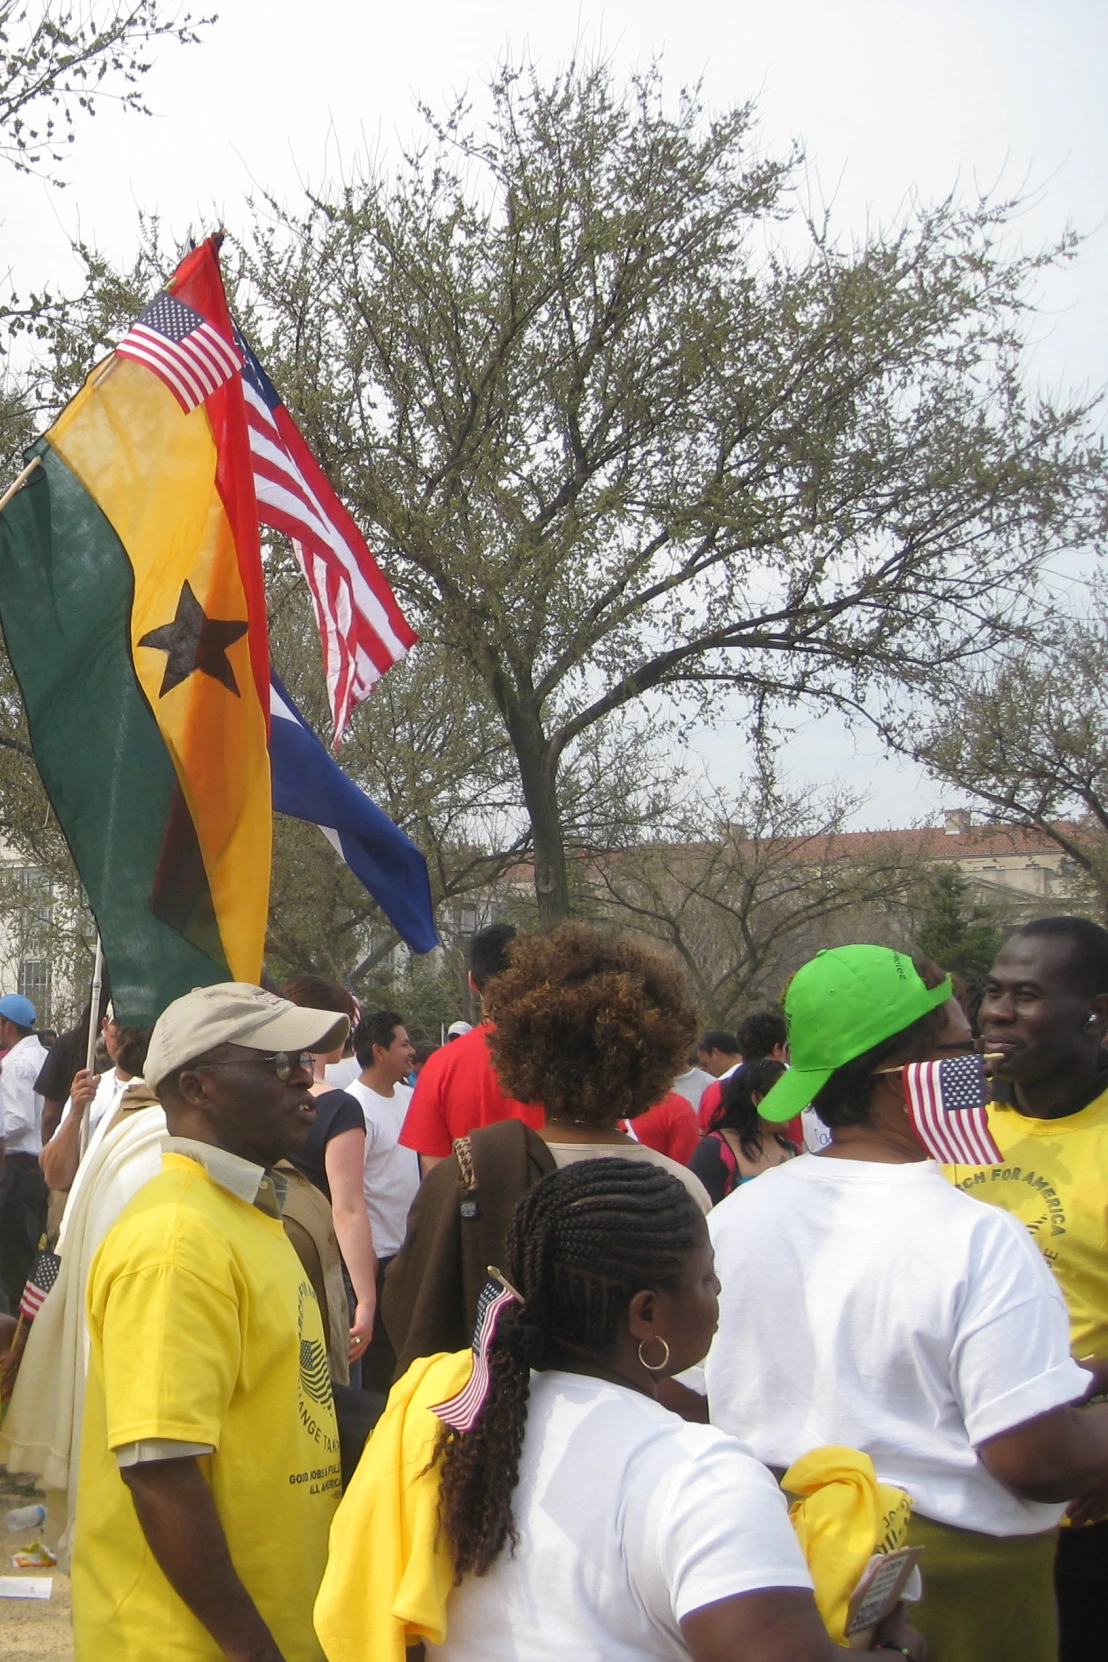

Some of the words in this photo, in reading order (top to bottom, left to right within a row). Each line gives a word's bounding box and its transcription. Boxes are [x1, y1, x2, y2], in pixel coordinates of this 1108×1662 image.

[992, 1167, 1022, 1182] FOR
[1021, 1171, 1066, 1237] AMERICA
[289, 1472, 308, 1485] GOOD
